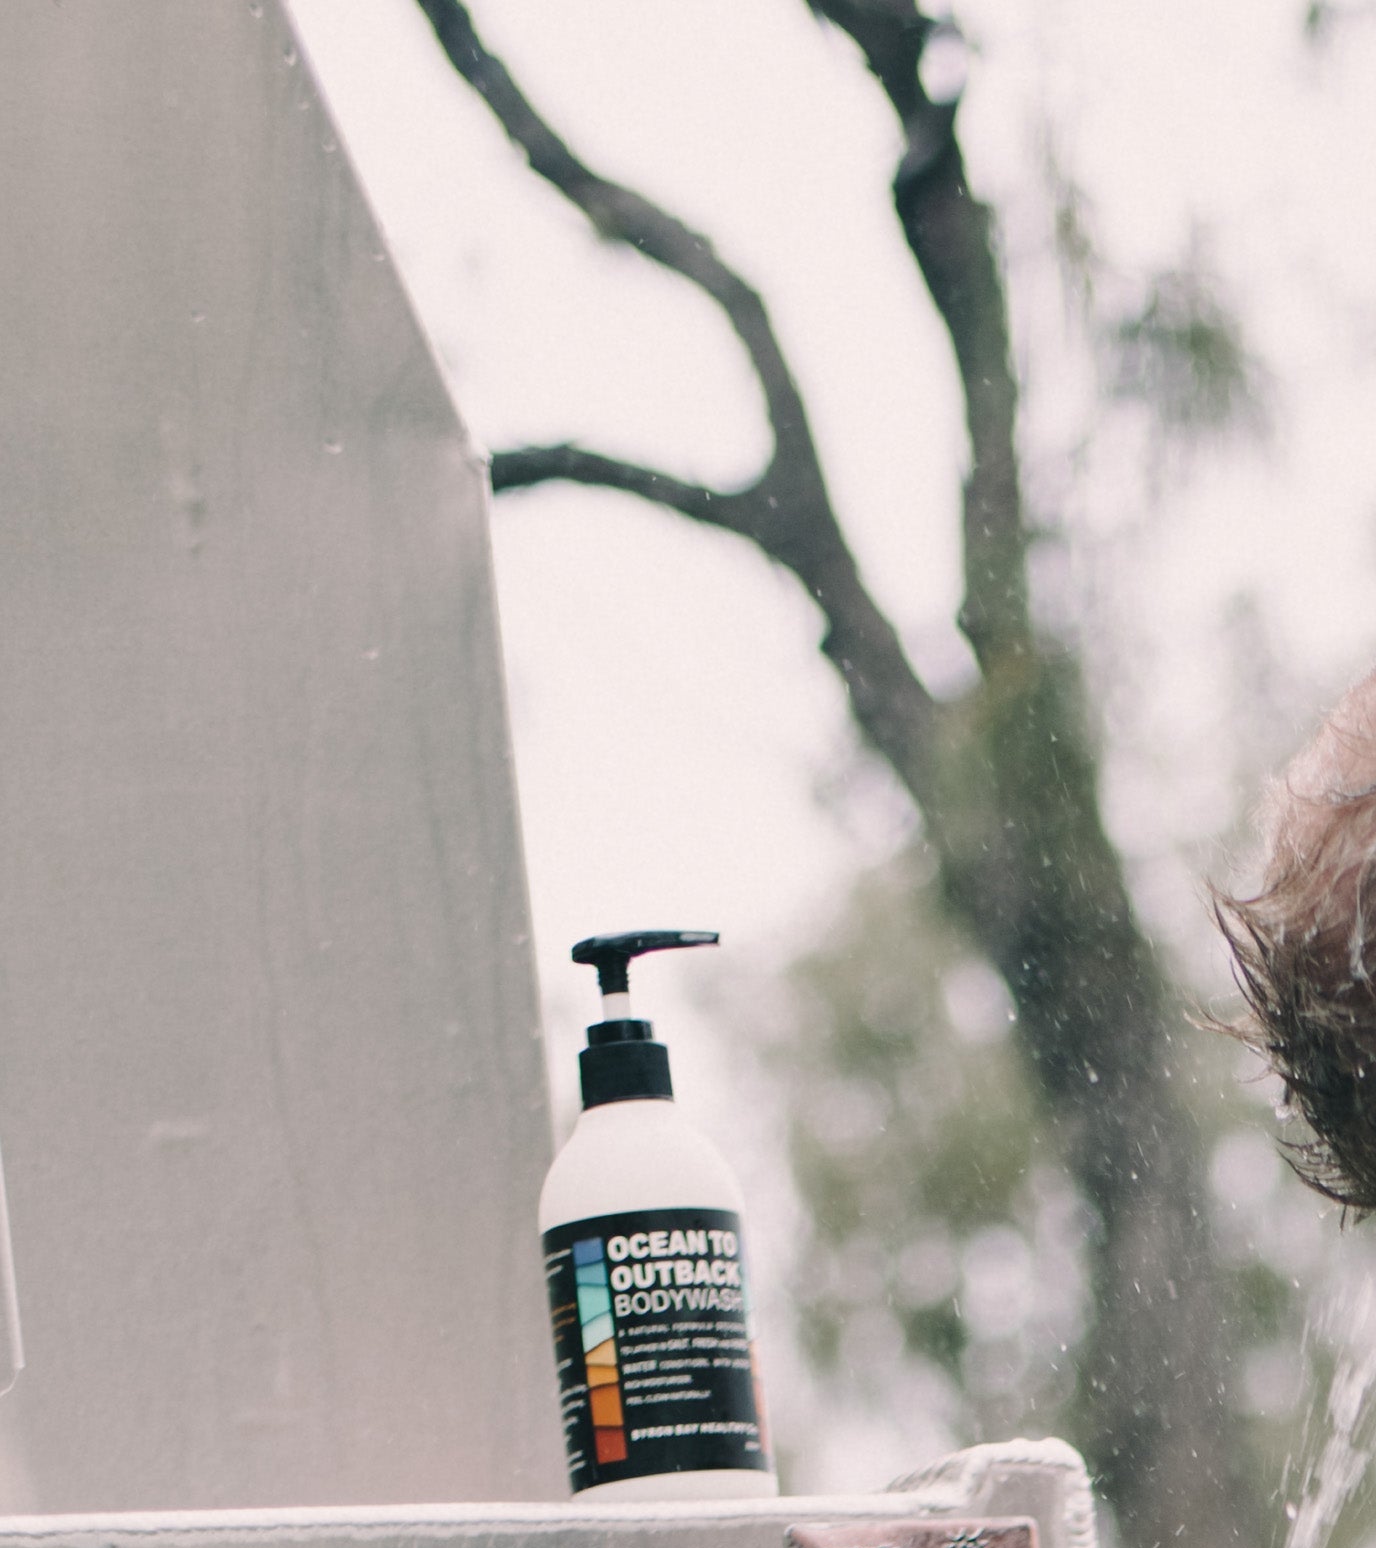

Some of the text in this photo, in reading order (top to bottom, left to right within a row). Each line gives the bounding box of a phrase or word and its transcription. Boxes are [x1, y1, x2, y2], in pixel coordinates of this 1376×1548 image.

[607, 1229, 709, 1262] OCEAN
[707, 1229, 738, 1258] TO
[610, 1259, 741, 1292] OUTBACK
